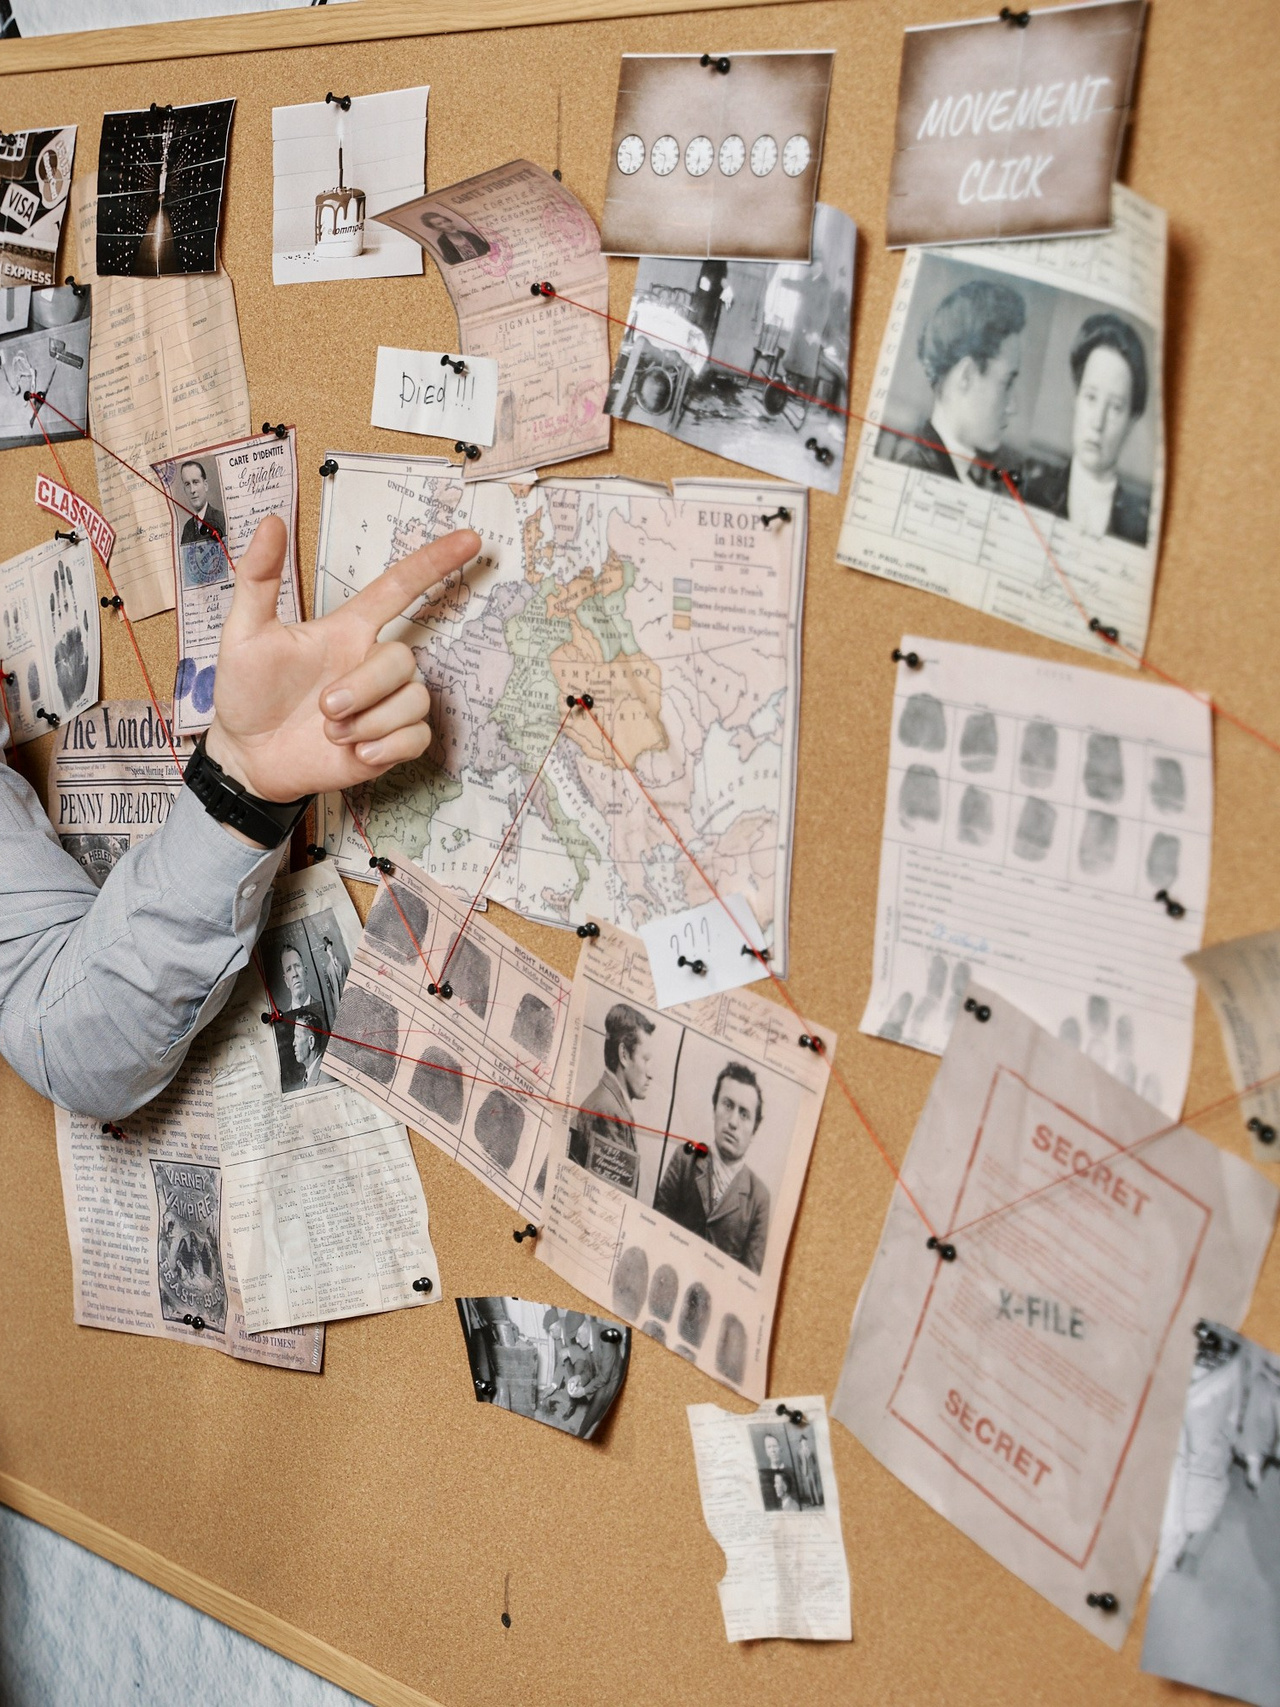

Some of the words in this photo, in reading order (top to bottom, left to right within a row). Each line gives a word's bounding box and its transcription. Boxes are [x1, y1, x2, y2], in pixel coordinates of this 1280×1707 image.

[917, 75, 1111, 140] MOVEMENT
[957, 155, 1054, 205] CLICK
[9, 187, 35, 222] VISA
[4, 262, 52, 285] EXPRESS
[229, 454, 249, 468] CARTE
[252, 445, 284, 461] D'IDENTITE
[387, 479, 415, 498] UNITED
[418, 493, 455, 514] KINGDOM
[37, 480, 112, 558] CLASSIFIED
[386, 514, 416, 533] GREAT
[715, 533, 725, 545] in
[730, 535, 755, 549] 1812
[836, 552, 869, 568] BUREAU
[693, 583, 718, 593] Empire
[740, 587, 764, 597] French
[518, 615, 573, 630] CONFEDERATION
[714, 603, 746, 614] dependent
[758, 608, 788, 620] Napoleon
[691, 619, 711, 630] States
[748, 625, 780, 637] Napoleon
[464, 659, 480, 670] Paris
[462, 711, 480, 724] THE
[527, 701, 556, 712] BAVARIA
[62, 715, 97, 750] The
[101, 707, 183, 749] London
[131, 766, 145, 778] Special
[145, 766, 164, 778] Morning
[754, 769, 779, 780] SEA
[549, 758, 587, 820] ADRIATIC
[58, 793, 104, 825] PENNY
[374, 814, 418, 843] SPAIN
[88, 850, 113, 864] HEELED
[406, 874, 424, 893] Thumb
[514, 946, 537, 968] RIGHT
[538, 963, 561, 984] HAND
[521, 963, 539, 981] Middle
[540, 977, 555, 992] finger
[373, 985, 394, 1002] Thumb
[437, 1027, 451, 1040] Index
[451, 1037, 465, 1054] finger
[493, 1059, 513, 1076] LEFT
[514, 1074, 535, 1094] HAND
[169, 1129, 188, 1140] opposing
[164, 1168, 209, 1191] VARNEY
[1032, 1124, 1151, 1217] SECRET
[162, 1184, 214, 1219] VAMPIRE
[159, 1257, 197, 1306] FEAST
[995, 1288, 1084, 1339] X-FILE
[270, 1337, 297, 1350] TIMES!!
[944, 1388, 1053, 1486] SECRET
